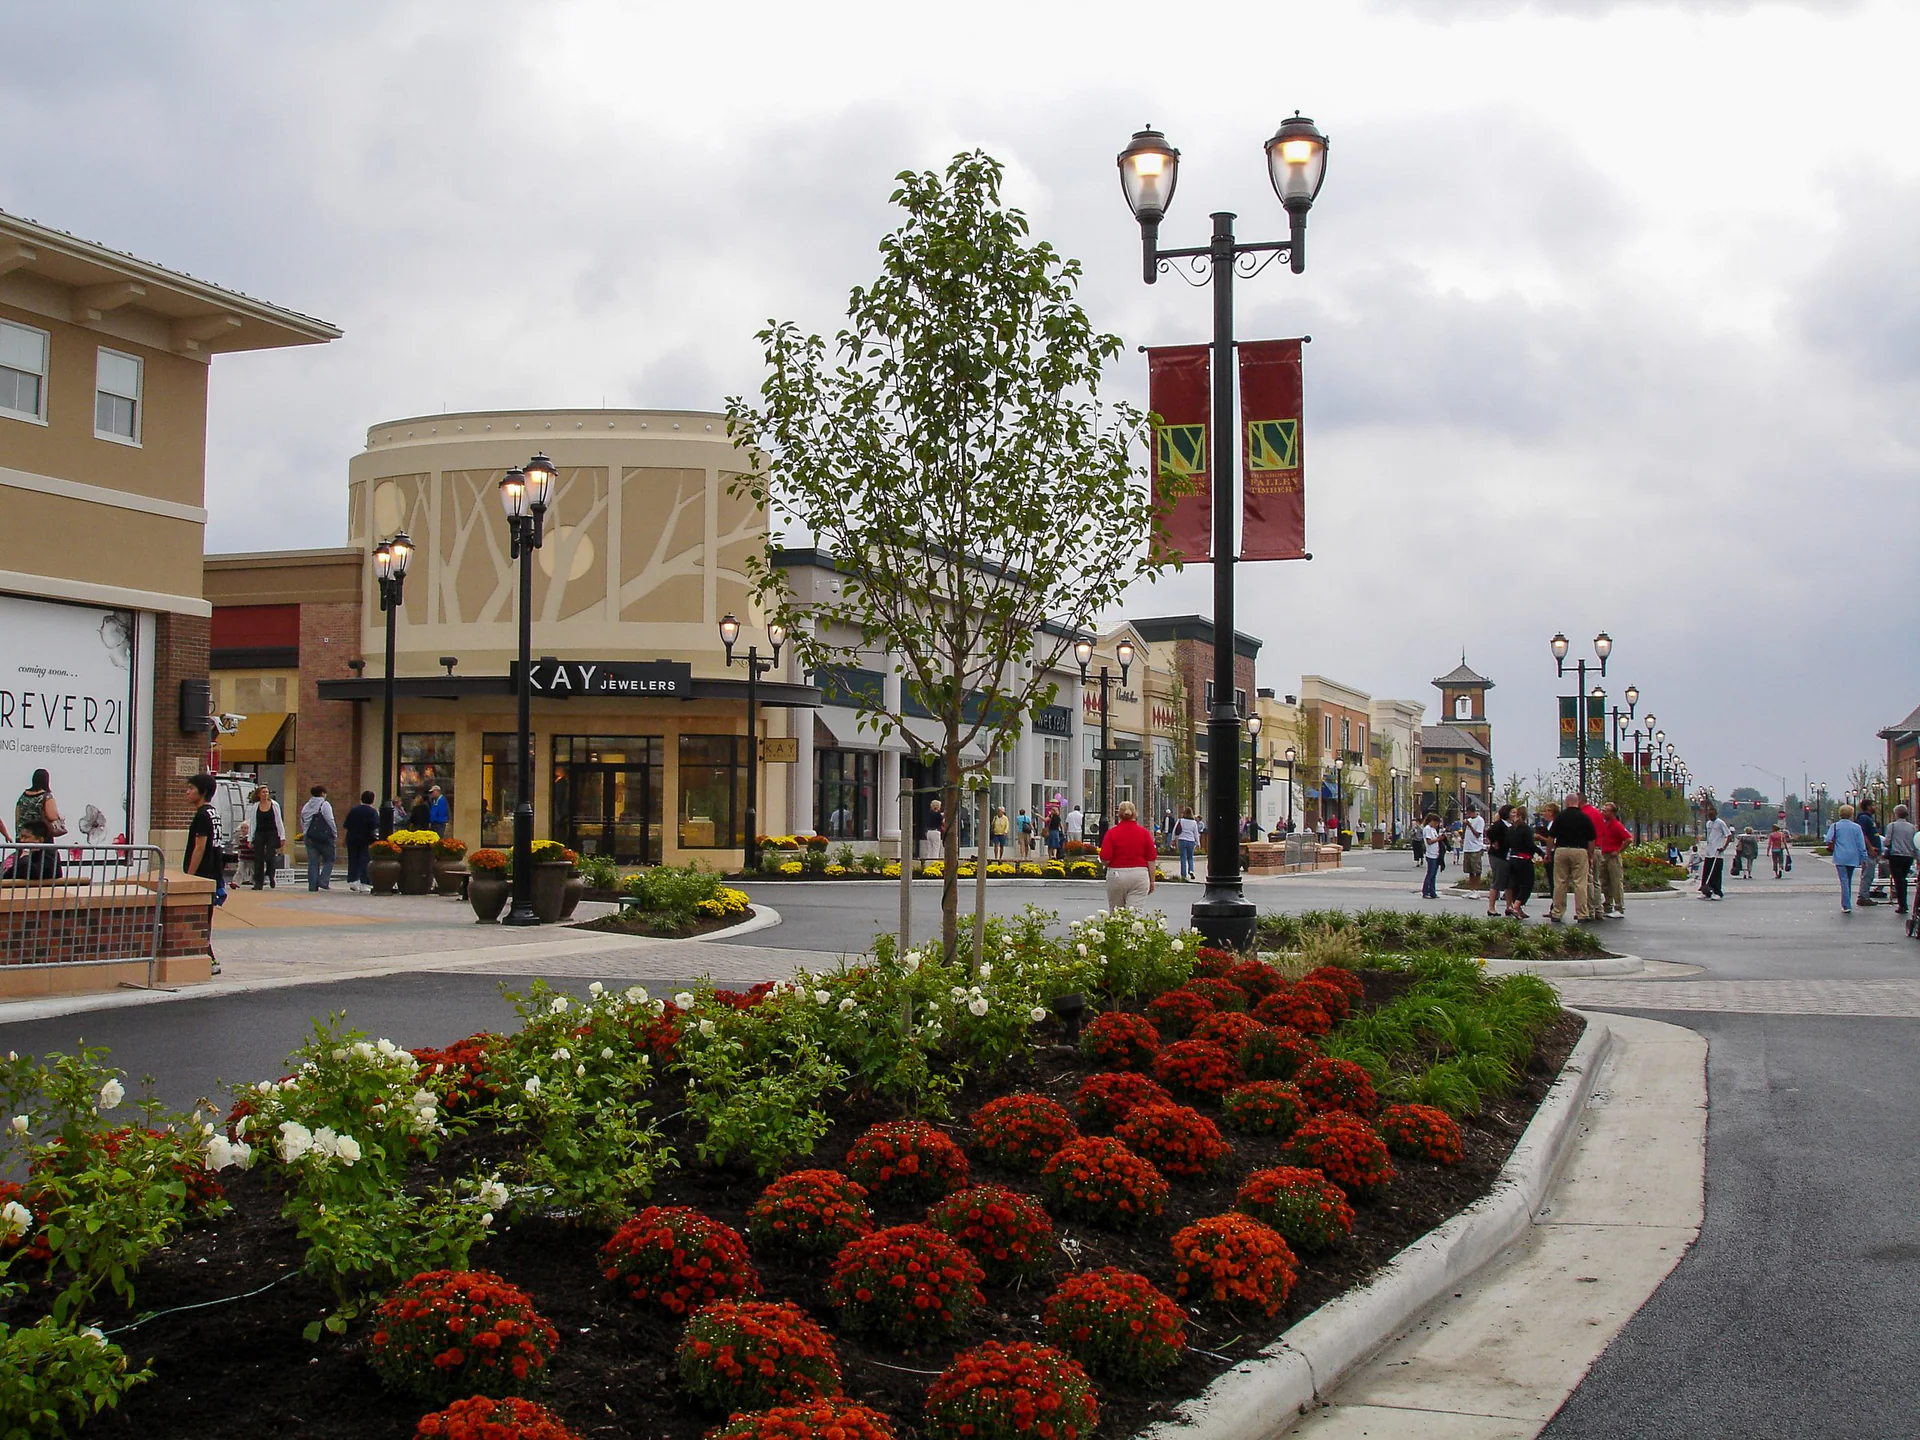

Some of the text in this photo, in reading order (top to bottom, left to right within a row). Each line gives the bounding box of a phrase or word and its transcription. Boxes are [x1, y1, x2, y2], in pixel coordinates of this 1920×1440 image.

[18, 665, 46, 678] coming
[600, 680, 676, 691] JEWELERS
[20, 743, 112, 755] careers@forever21.com
[766, 743, 795, 753] KAY
